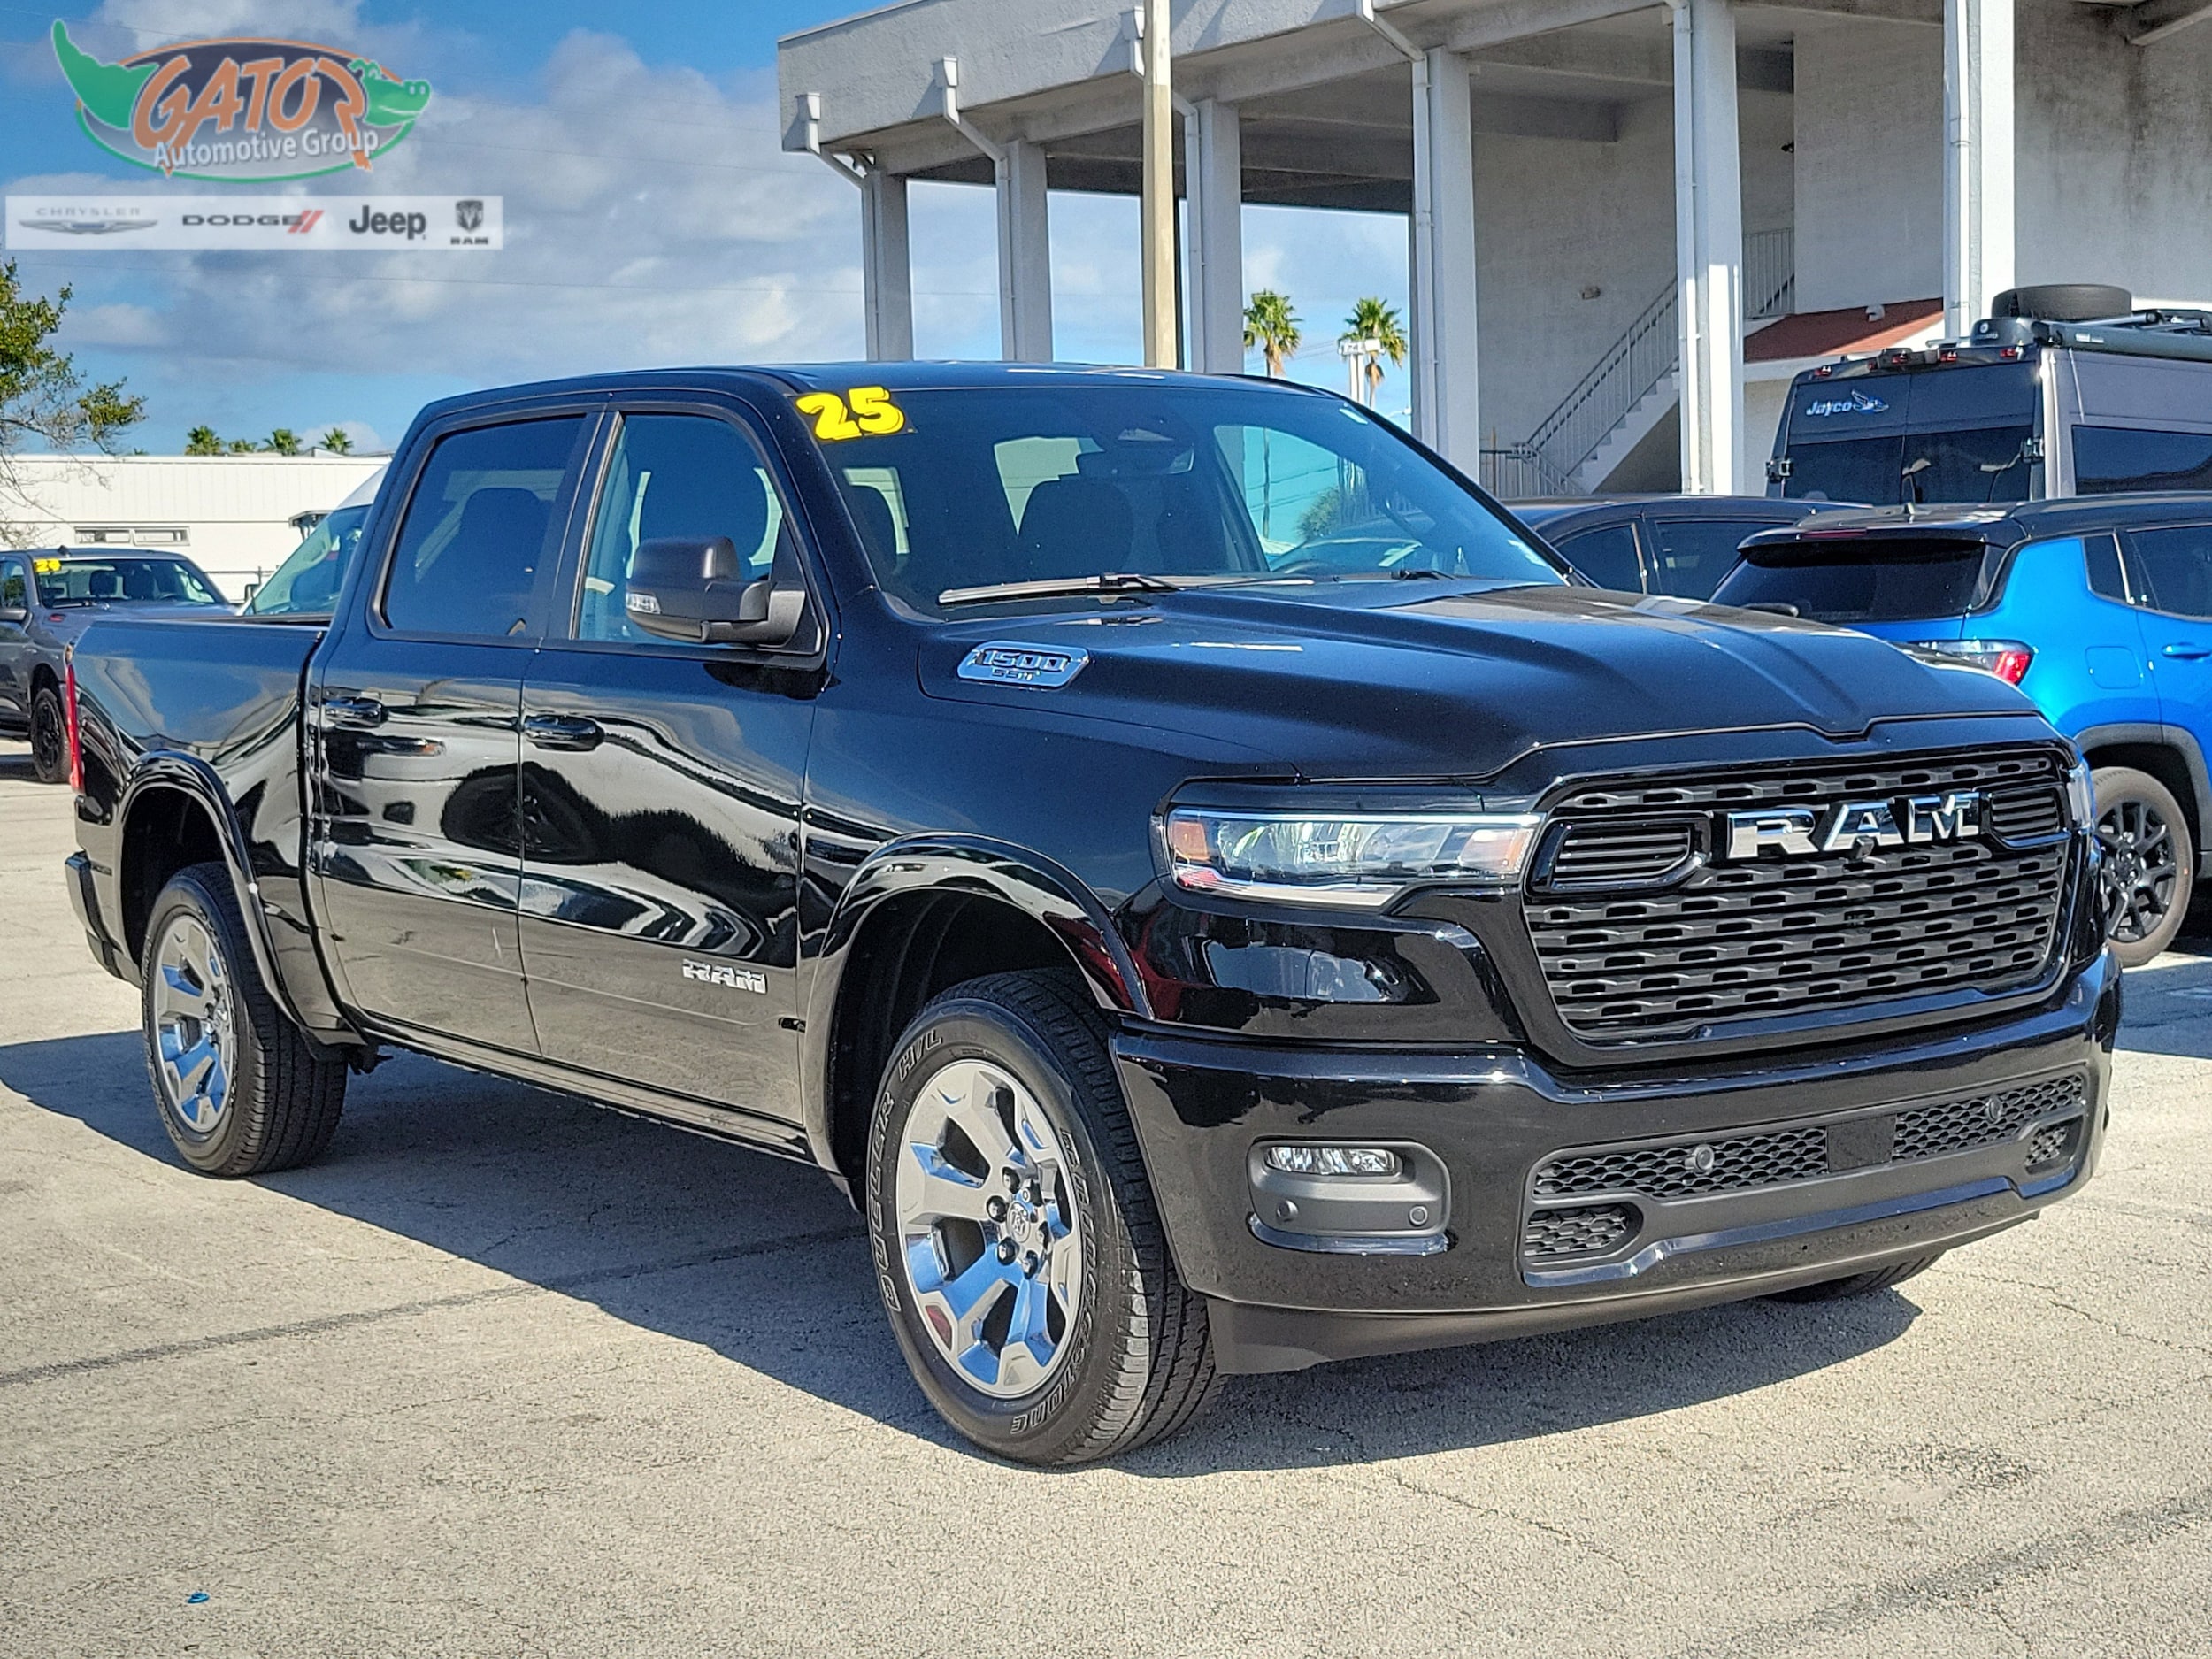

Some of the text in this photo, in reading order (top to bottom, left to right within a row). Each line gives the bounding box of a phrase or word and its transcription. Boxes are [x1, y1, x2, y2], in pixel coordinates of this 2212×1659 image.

[795, 386, 905, 441] 25
[1806, 401, 1854, 417] Jayco
[983, 649, 1070, 672] 1500
[1726, 791, 1980, 859] RAM
[682, 958, 767, 995] RAM
[869, 1091, 901, 1311] DUELER
[1010, 1130, 1098, 1434] BRIDGESTONE
